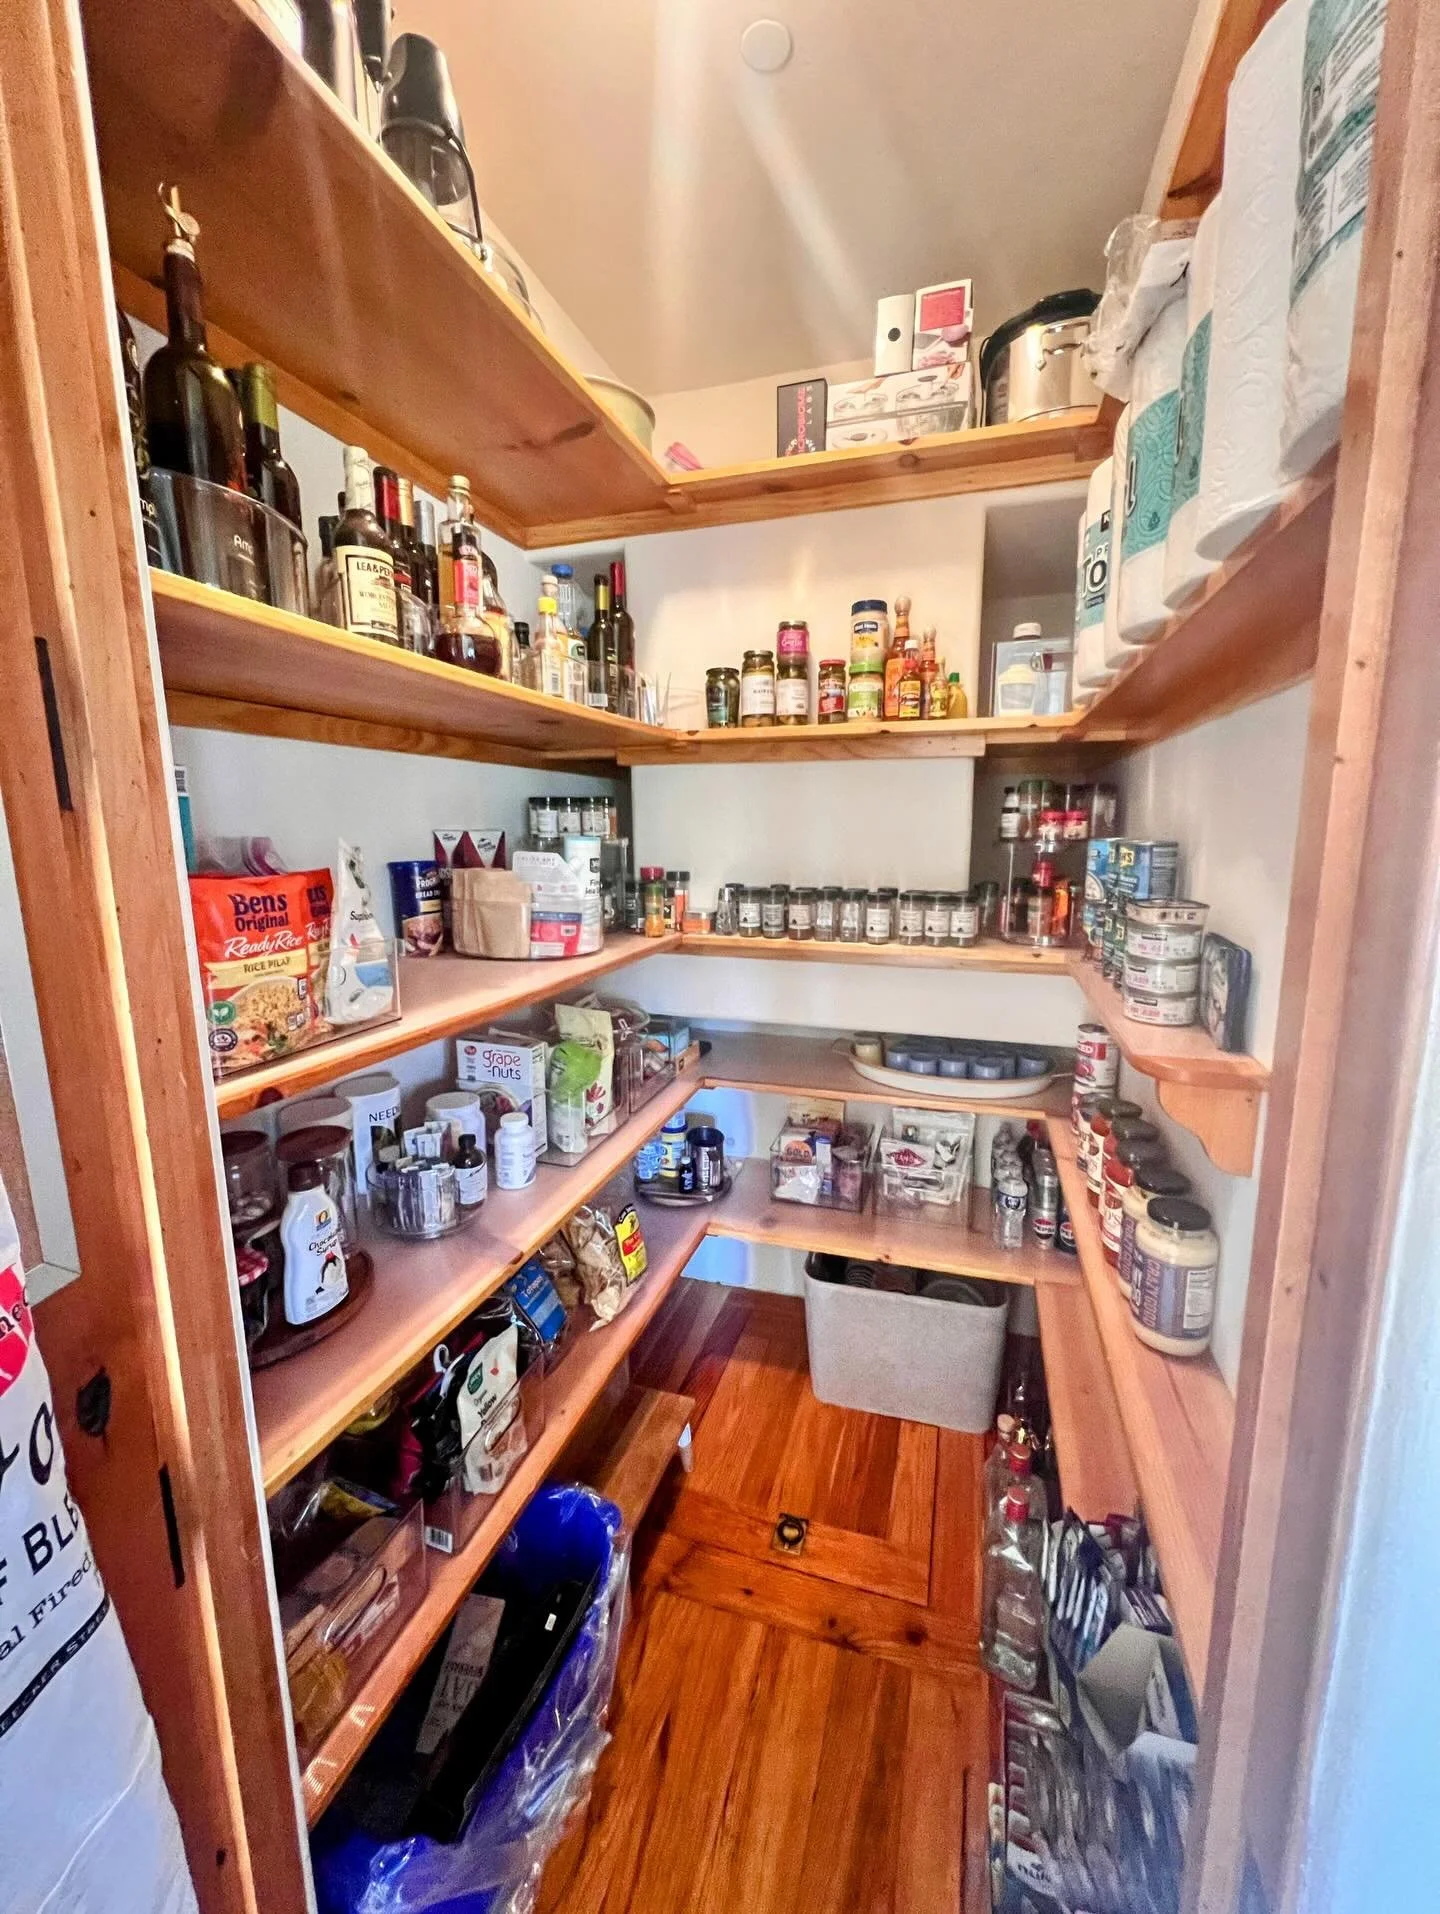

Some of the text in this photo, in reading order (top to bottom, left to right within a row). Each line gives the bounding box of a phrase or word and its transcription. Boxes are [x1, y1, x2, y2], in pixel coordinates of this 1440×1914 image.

[235, 912, 289, 933] Original
[483, 1049, 521, 1068] grape
[28, 1551, 92, 1631] Fired
